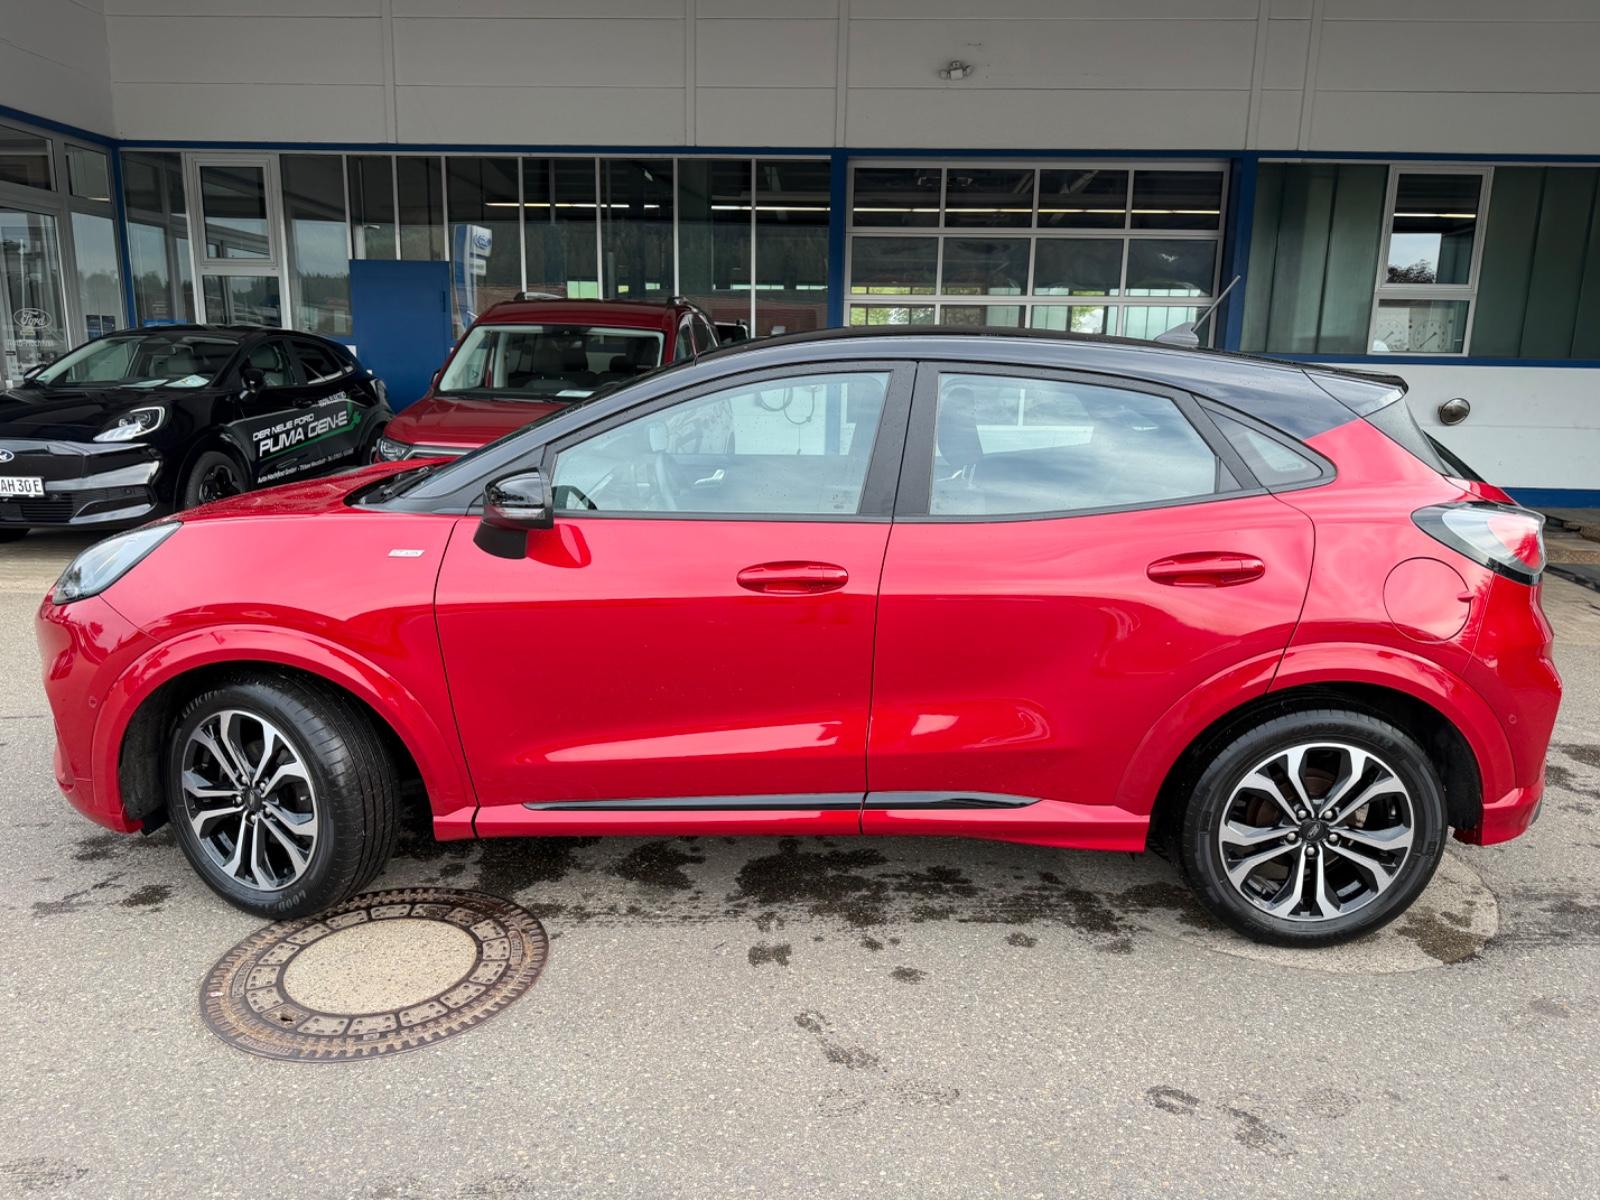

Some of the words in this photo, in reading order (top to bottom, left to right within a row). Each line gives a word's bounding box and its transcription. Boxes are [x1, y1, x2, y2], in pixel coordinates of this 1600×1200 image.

[20, 311, 46, 326] Ford
[252, 428, 271, 442] DER
[271, 419, 293, 434] NEUE
[294, 413, 315, 426] FORD
[259, 427, 305, 457] PUMA
[307, 410, 348, 438] GEN-E
[1, 479, 16, 493] AH
